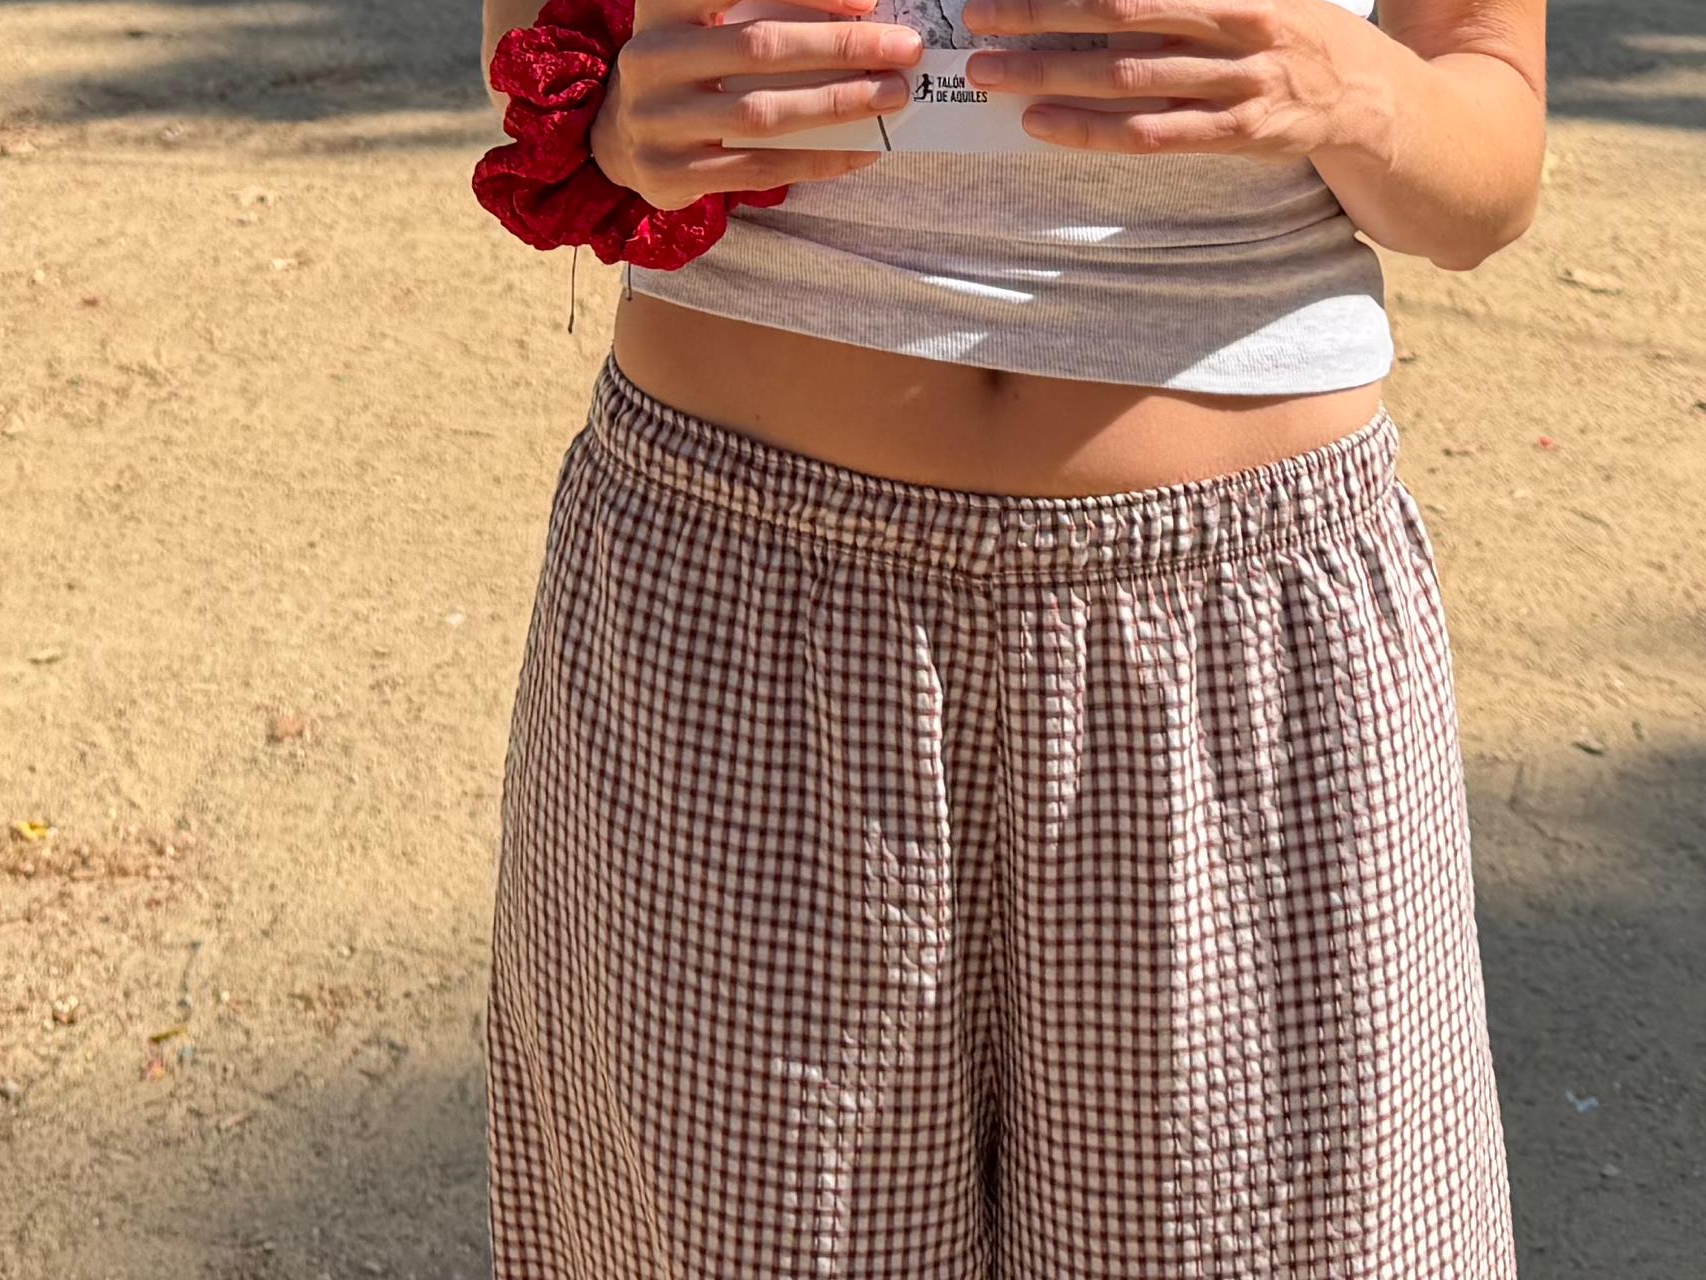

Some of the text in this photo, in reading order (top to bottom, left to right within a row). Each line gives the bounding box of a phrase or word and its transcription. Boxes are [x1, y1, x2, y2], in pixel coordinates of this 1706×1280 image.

[936, 74, 966, 89] TALÓN
[936, 90, 988, 103] DE AQUILES
